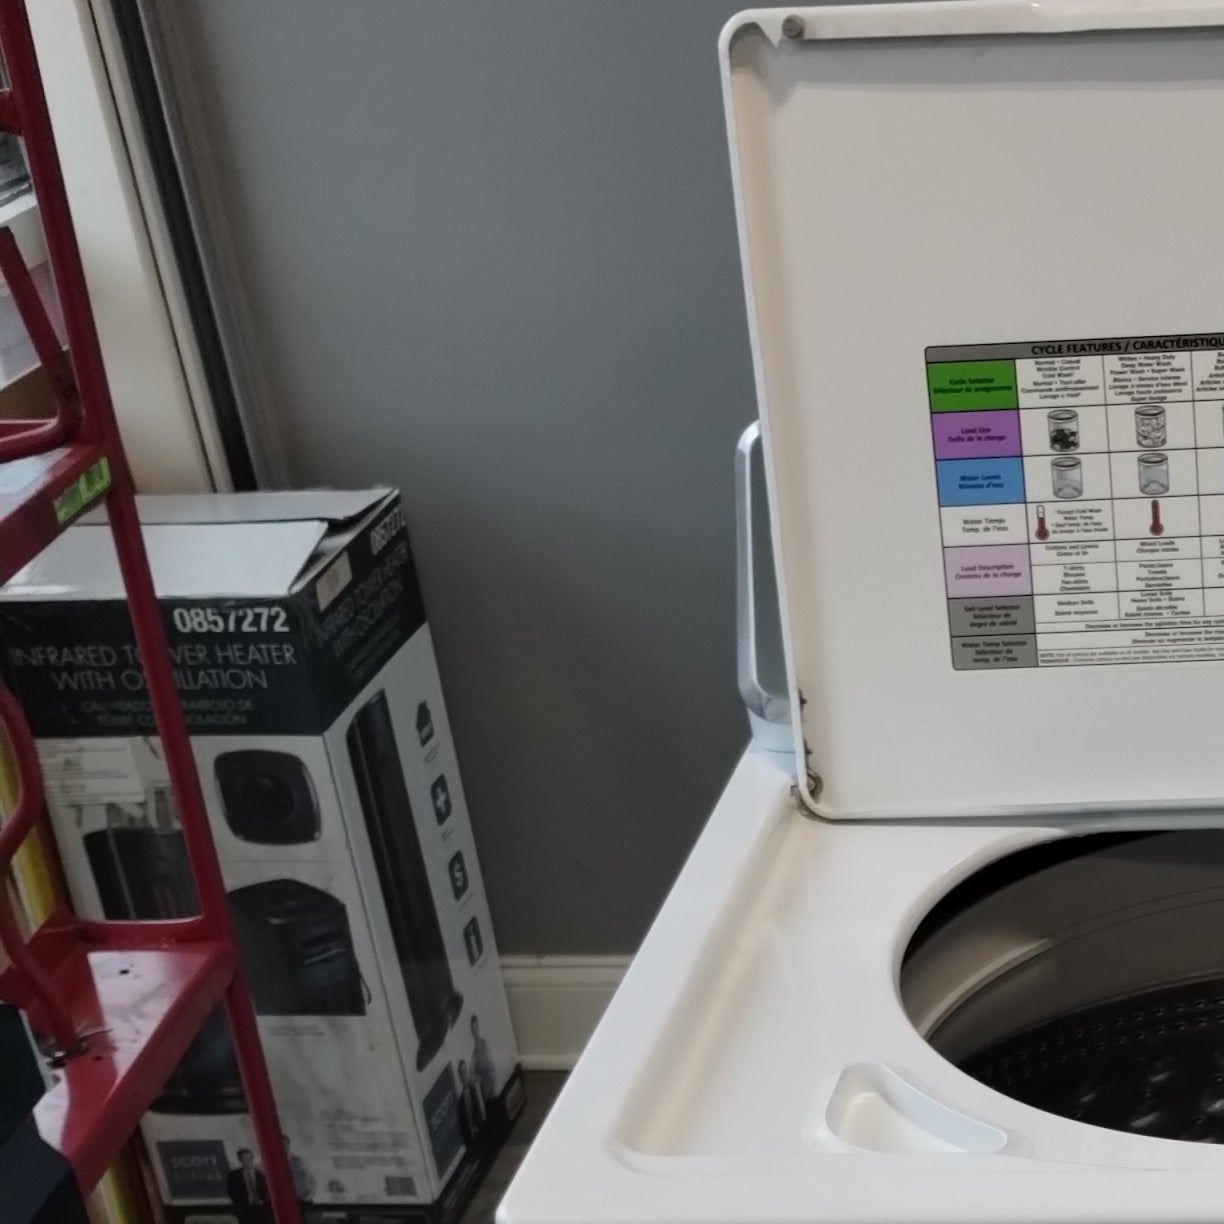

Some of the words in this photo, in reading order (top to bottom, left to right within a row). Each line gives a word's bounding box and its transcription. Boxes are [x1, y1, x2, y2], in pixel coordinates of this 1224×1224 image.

[1032, 344, 1063, 355] CYCLE
[1066, 342, 1121, 353] FEATURES
[1124, 341, 1129, 352] /
[173, 607, 290, 634] 0857272
[10, 645, 118, 667] INFRARED
[216, 643, 297, 665] HEATER
[50, 671, 116, 691] WITH
[121, 669, 269, 691] OILLATION
